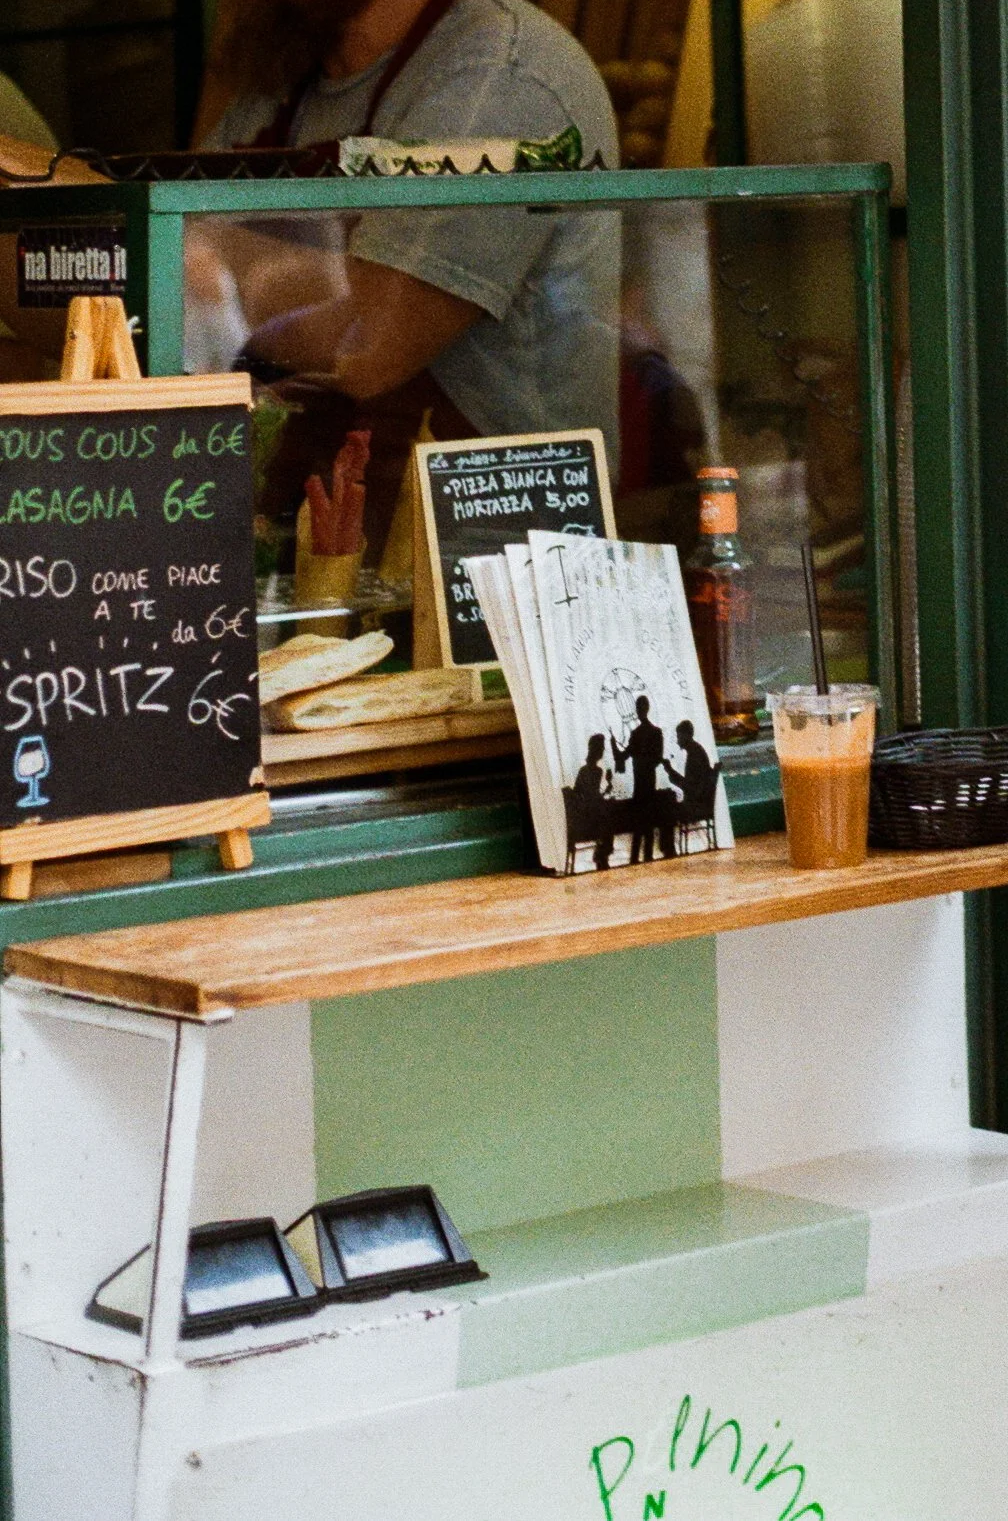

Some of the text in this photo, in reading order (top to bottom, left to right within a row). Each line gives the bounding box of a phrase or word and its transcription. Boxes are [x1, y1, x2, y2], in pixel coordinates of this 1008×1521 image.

[0, 422, 246, 462] OUS COUS da 6€
[448, 466, 588, 498] PIZZA BIANCA CON
[0, 478, 216, 524] ASAGNA 6€
[453, 490, 590, 521] MORTAZZA 5,00
[92, 568, 149, 595] COME
[168, 563, 222, 586] PIACE
[94, 599, 156, 621] A TE
[172, 604, 250, 645] da 6€
[4, 662, 251, 741] SPRITZ 6€
